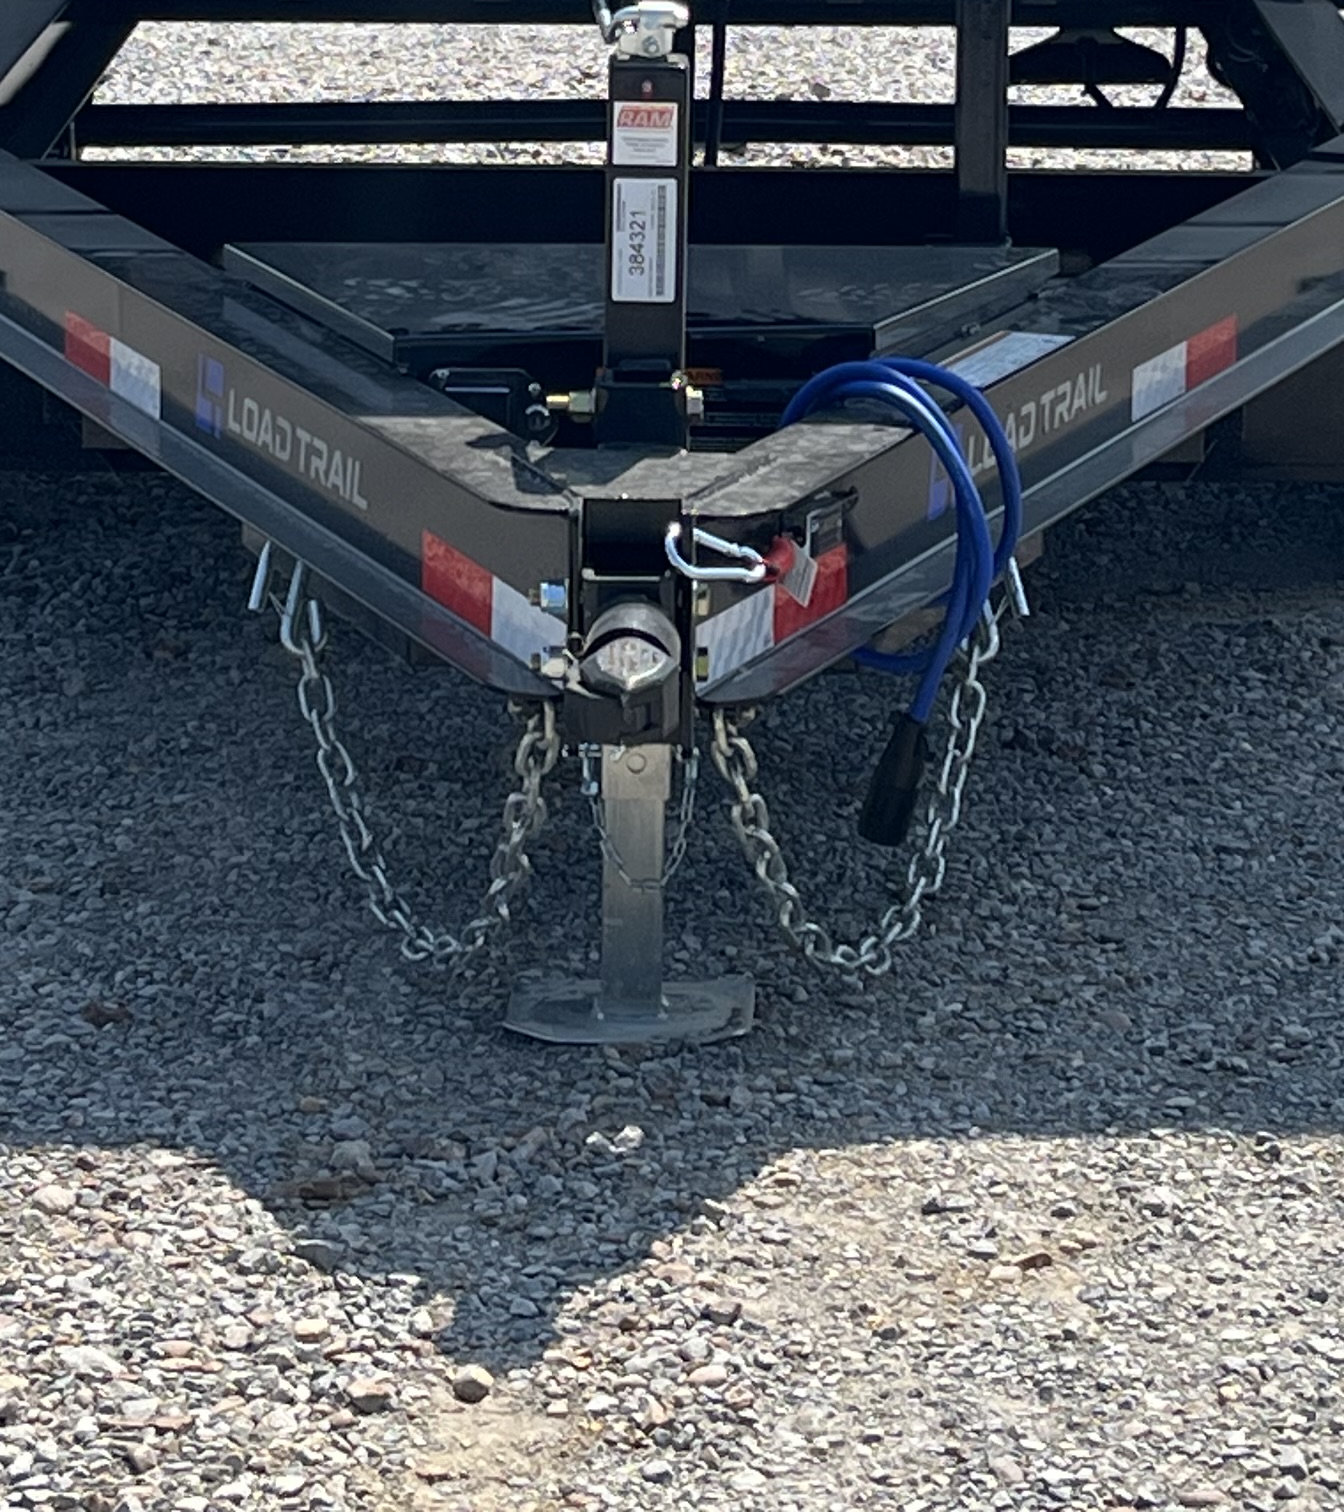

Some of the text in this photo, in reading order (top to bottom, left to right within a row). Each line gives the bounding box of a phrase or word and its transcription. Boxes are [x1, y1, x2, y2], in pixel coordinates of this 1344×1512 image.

[618, 108, 672, 128] RAM
[628, 210, 647, 276] 384321
[1040, 362, 1109, 434] TRAIL
[227, 388, 368, 511] LOAD TRAIL
